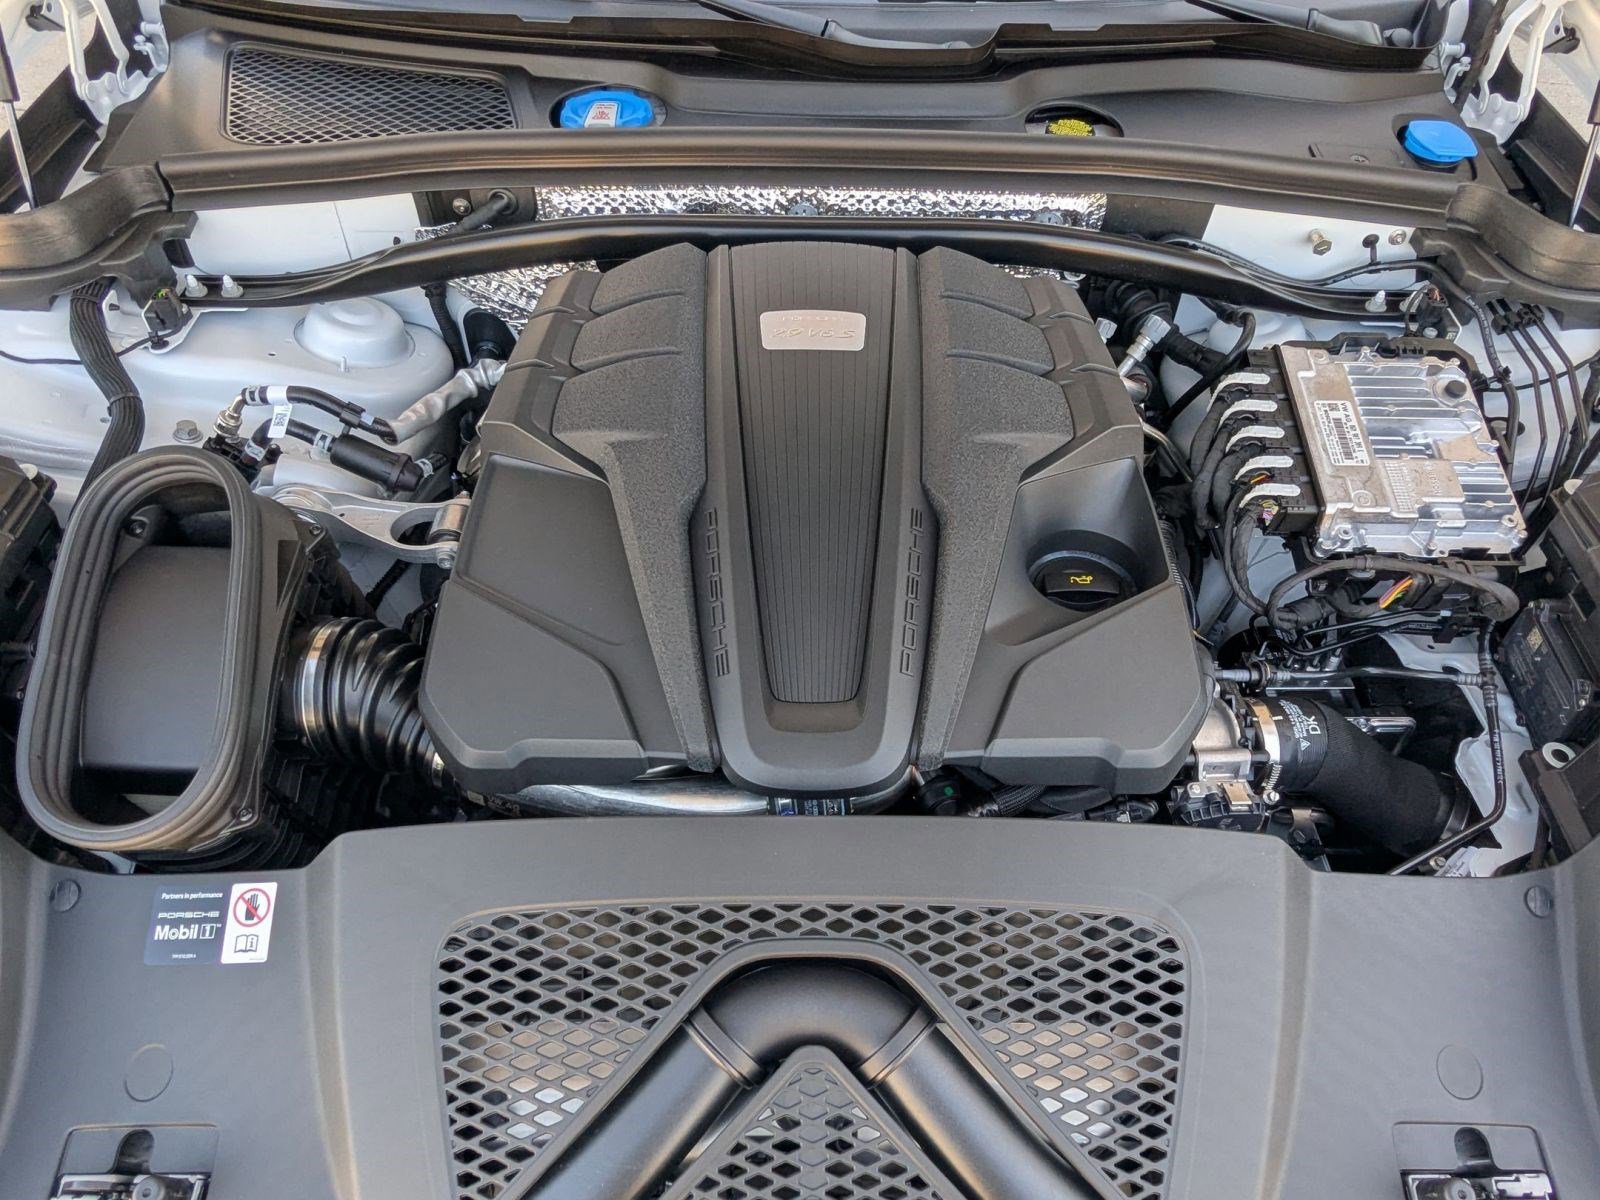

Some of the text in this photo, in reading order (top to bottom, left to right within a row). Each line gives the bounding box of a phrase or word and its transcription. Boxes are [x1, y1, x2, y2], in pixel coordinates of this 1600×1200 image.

[1340, 402, 1350, 413] VW
[1343, 413, 1352, 423] AG
[705, 507, 730, 678] PORSCHE
[899, 507, 923, 678] PORSCHE
[1305, 715, 1321, 735] DK
[189, 892, 223, 900] performance
[158, 911, 220, 919] PORSCHE
[154, 924, 199, 940] Mobil
